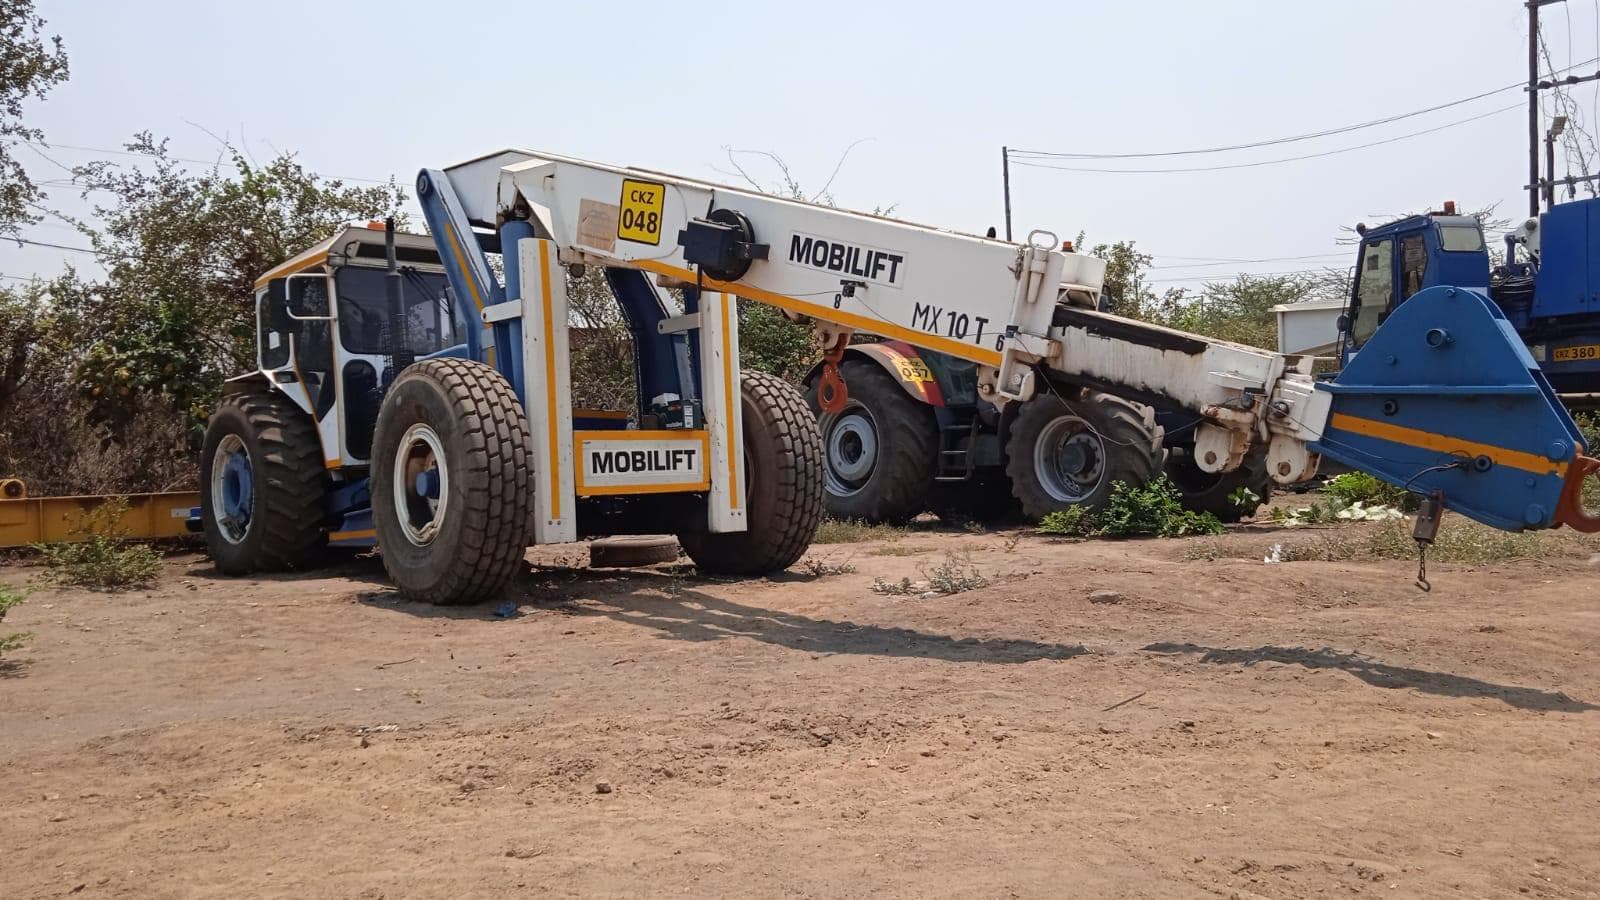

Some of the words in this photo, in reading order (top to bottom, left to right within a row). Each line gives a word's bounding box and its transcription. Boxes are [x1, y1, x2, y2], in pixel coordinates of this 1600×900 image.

[630, 189, 655, 205] CKZ
[622, 208, 658, 234] 048
[789, 234, 903, 284] MOBILIFT
[834, 294, 842, 309] 8
[912, 302, 943, 334] MX
[947, 311, 969, 340] 10
[975, 316, 989, 344] T
[995, 334, 1005, 352] 6
[1572, 347, 1595, 358] 380
[592, 450, 696, 474] MOBILIFT
